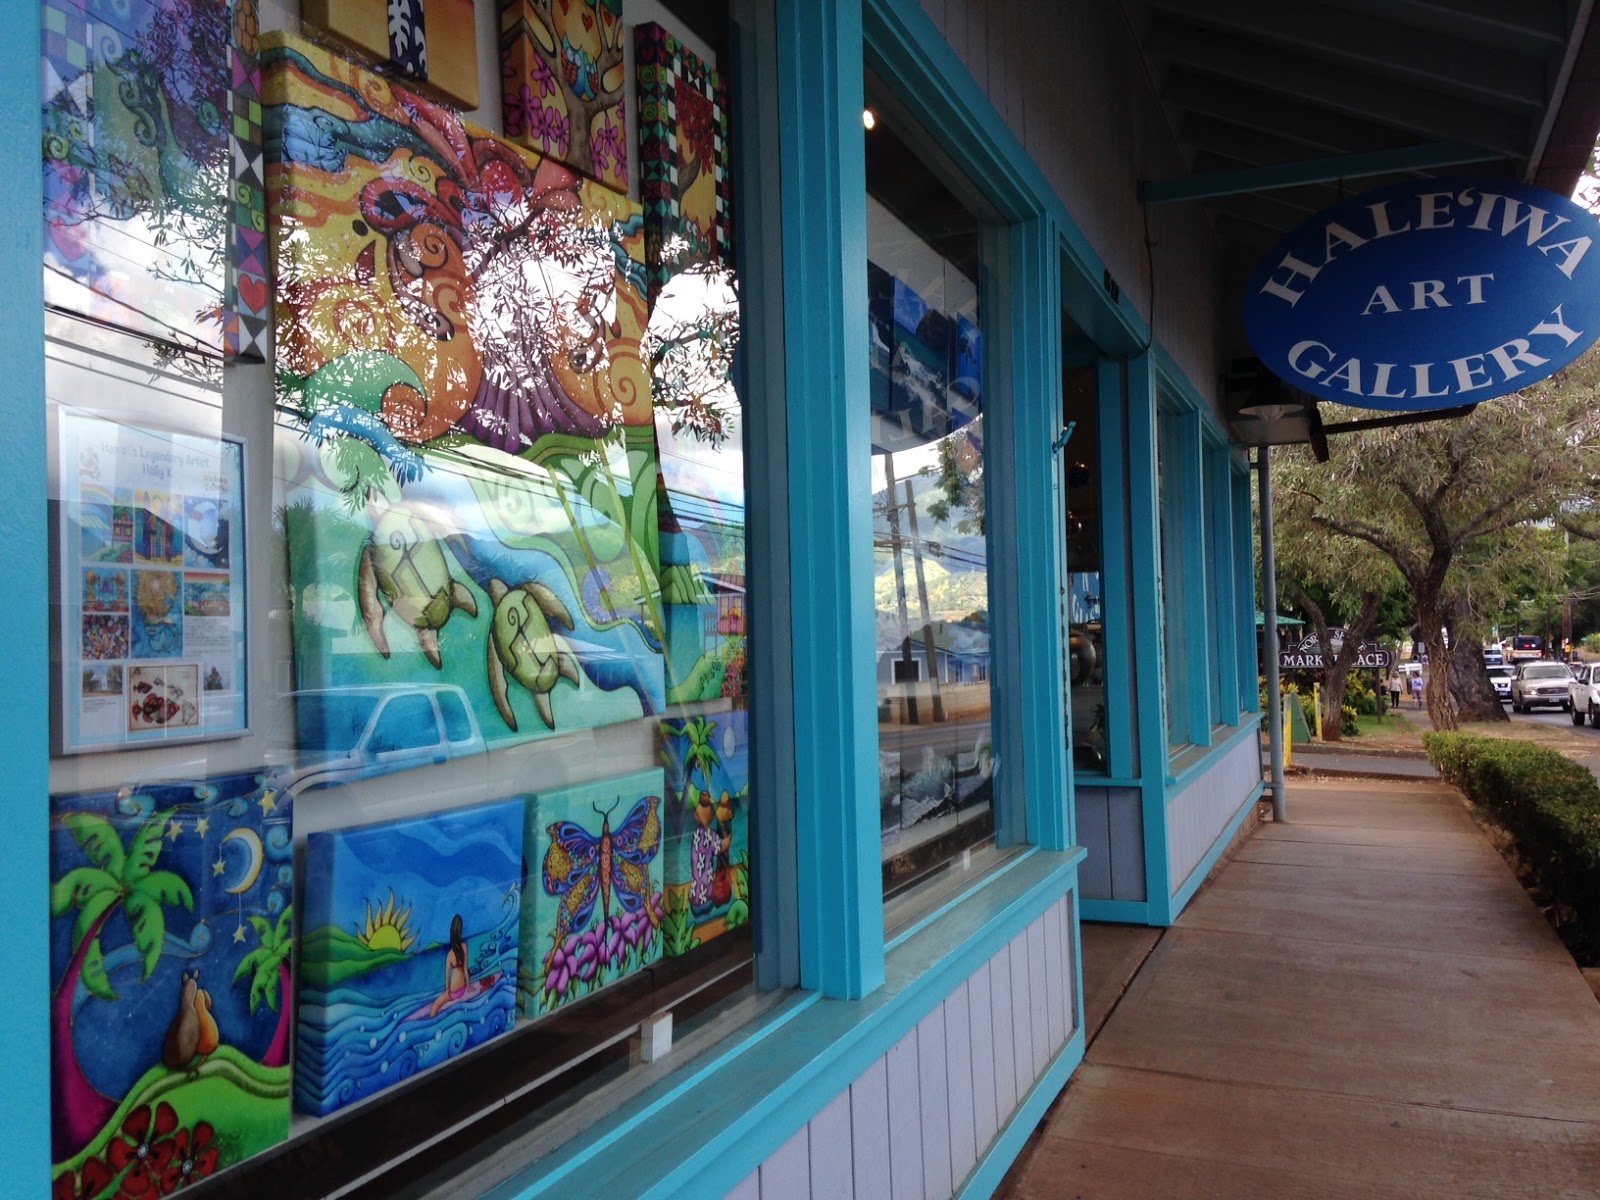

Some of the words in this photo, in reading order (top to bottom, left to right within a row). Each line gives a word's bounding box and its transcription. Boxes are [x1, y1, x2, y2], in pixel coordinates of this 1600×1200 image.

[1360, 273, 1494, 315] ART
[1287, 303, 1584, 398] GALLERY
[142, 463, 165, 480] Holly
[167, 467, 172, 478] K
